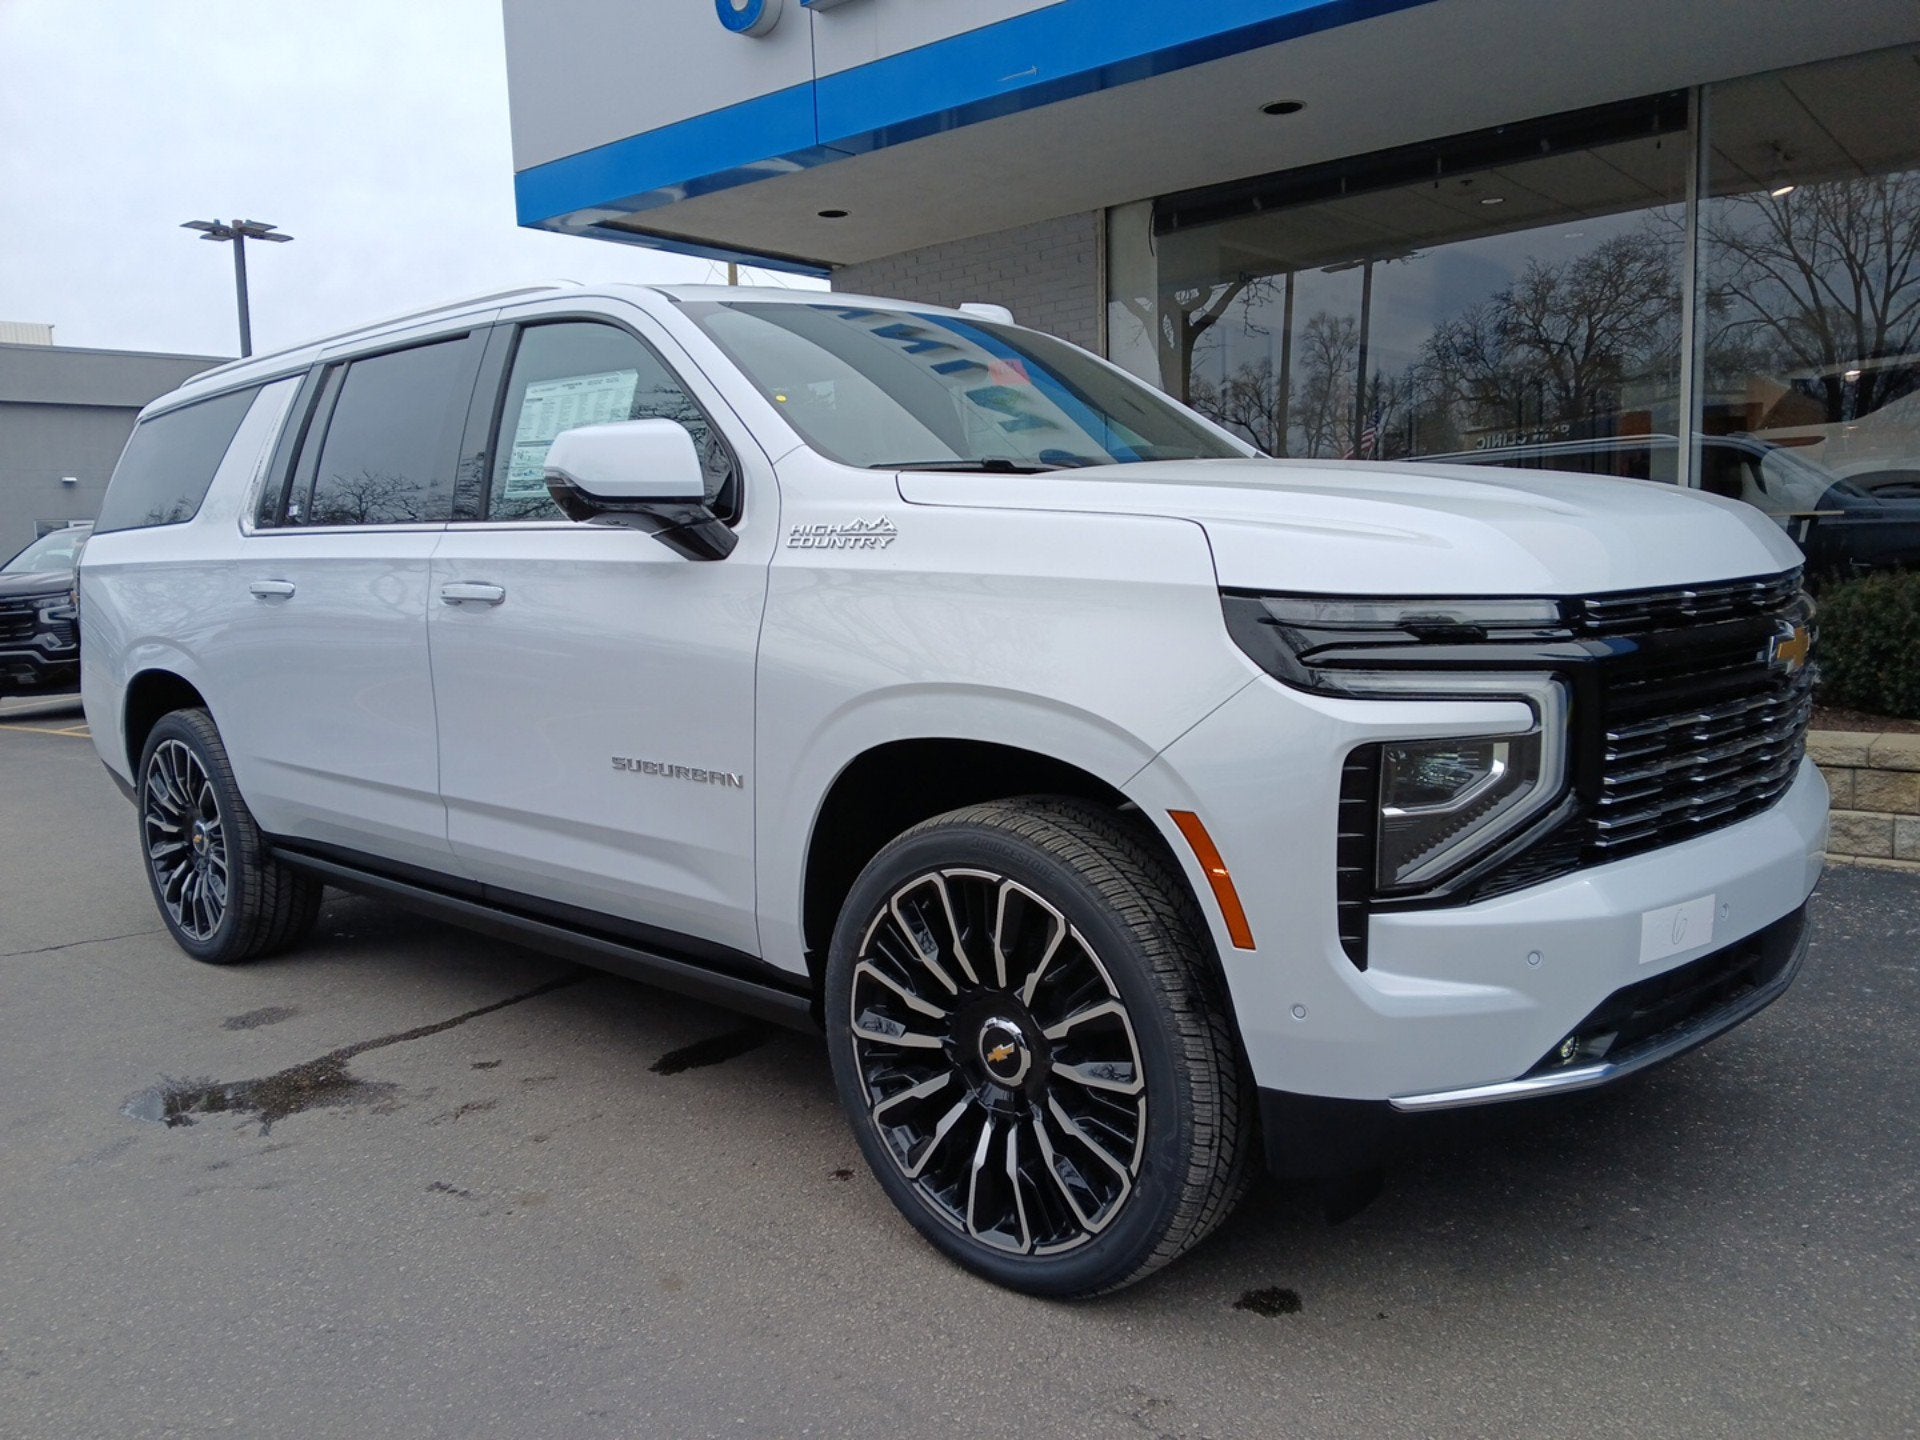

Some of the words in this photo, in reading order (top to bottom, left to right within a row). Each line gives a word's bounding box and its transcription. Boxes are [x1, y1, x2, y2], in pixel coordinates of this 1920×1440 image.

[789, 524, 842, 537] HIGH
[786, 536, 896, 550] COUNTRY
[611, 755, 744, 789] SUBURBAN
